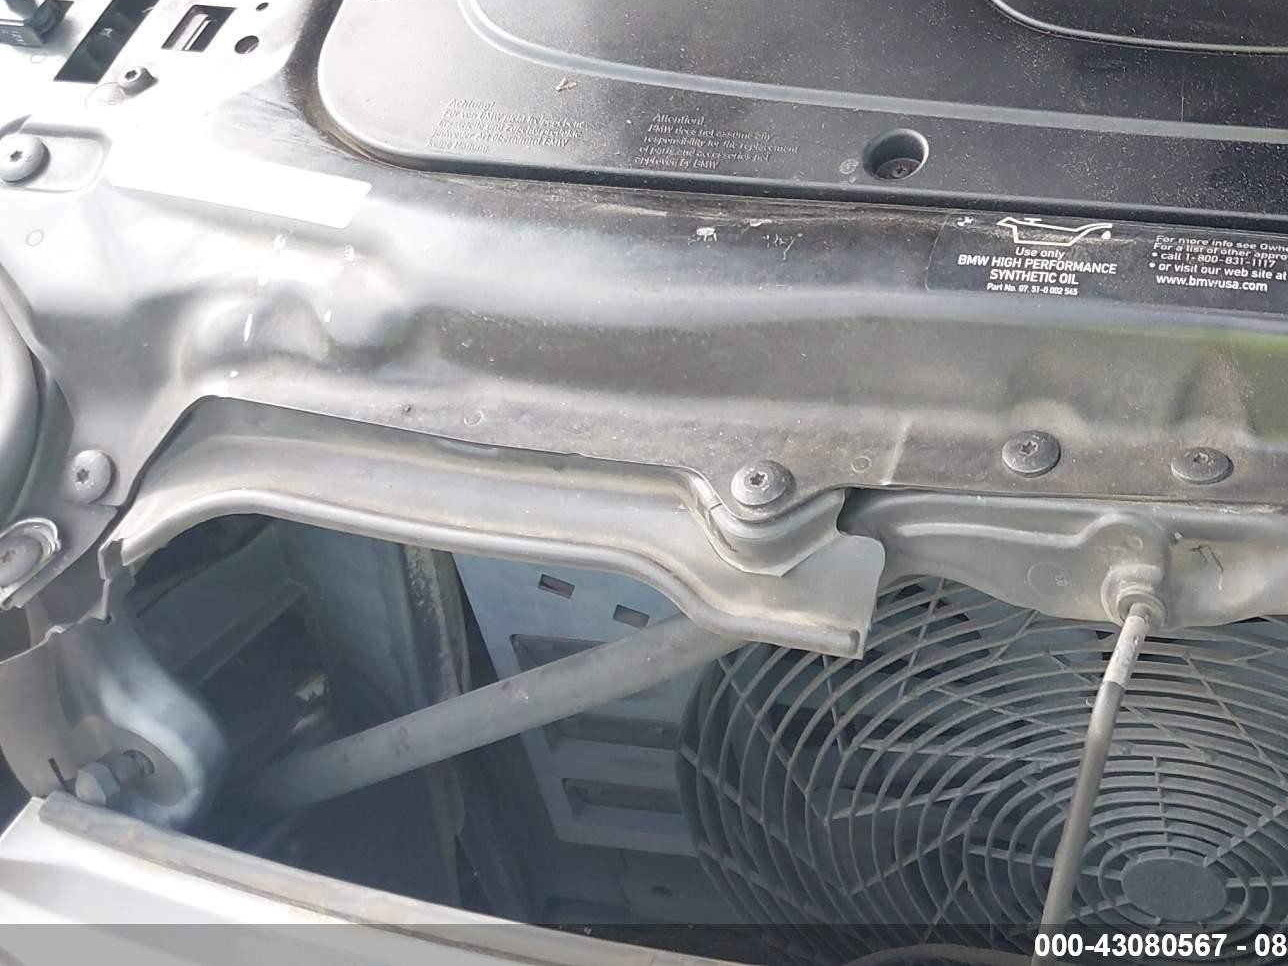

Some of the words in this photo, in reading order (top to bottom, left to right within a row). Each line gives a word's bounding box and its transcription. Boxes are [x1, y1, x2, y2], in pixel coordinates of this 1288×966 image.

[1156, 235, 1174, 243] For
[1178, 237, 1209, 246] more
[1212, 239, 1233, 247] info
[1015, 246, 1037, 257] Use
[1040, 248, 1065, 260] only
[1153, 243, 1174, 251] For
[1186, 245, 1203, 253] list
[1220, 247, 1251, 257] other
[1160, 252, 1181, 261] call
[957, 254, 989, 266] BMW
[991, 256, 1022, 268] HIGH
[1024, 258, 1118, 275] PERFORMANCE
[1158, 263, 1171, 271] or
[1174, 263, 1198, 273] visit
[1200, 265, 1221, 274] our
[1224, 266, 1249, 277] web
[1251, 269, 1273, 279] site
[1275, 271, 1287, 280] at
[989, 268, 1057, 284] SYNTHETIC
[1059, 272, 1080, 285] OIL
[1156, 273, 1268, 292] www.bmwusa.com
[986, 283, 1003, 291] Part
[1004, 283, 1017, 292] No.
[1049, 286, 1063, 295] 002
